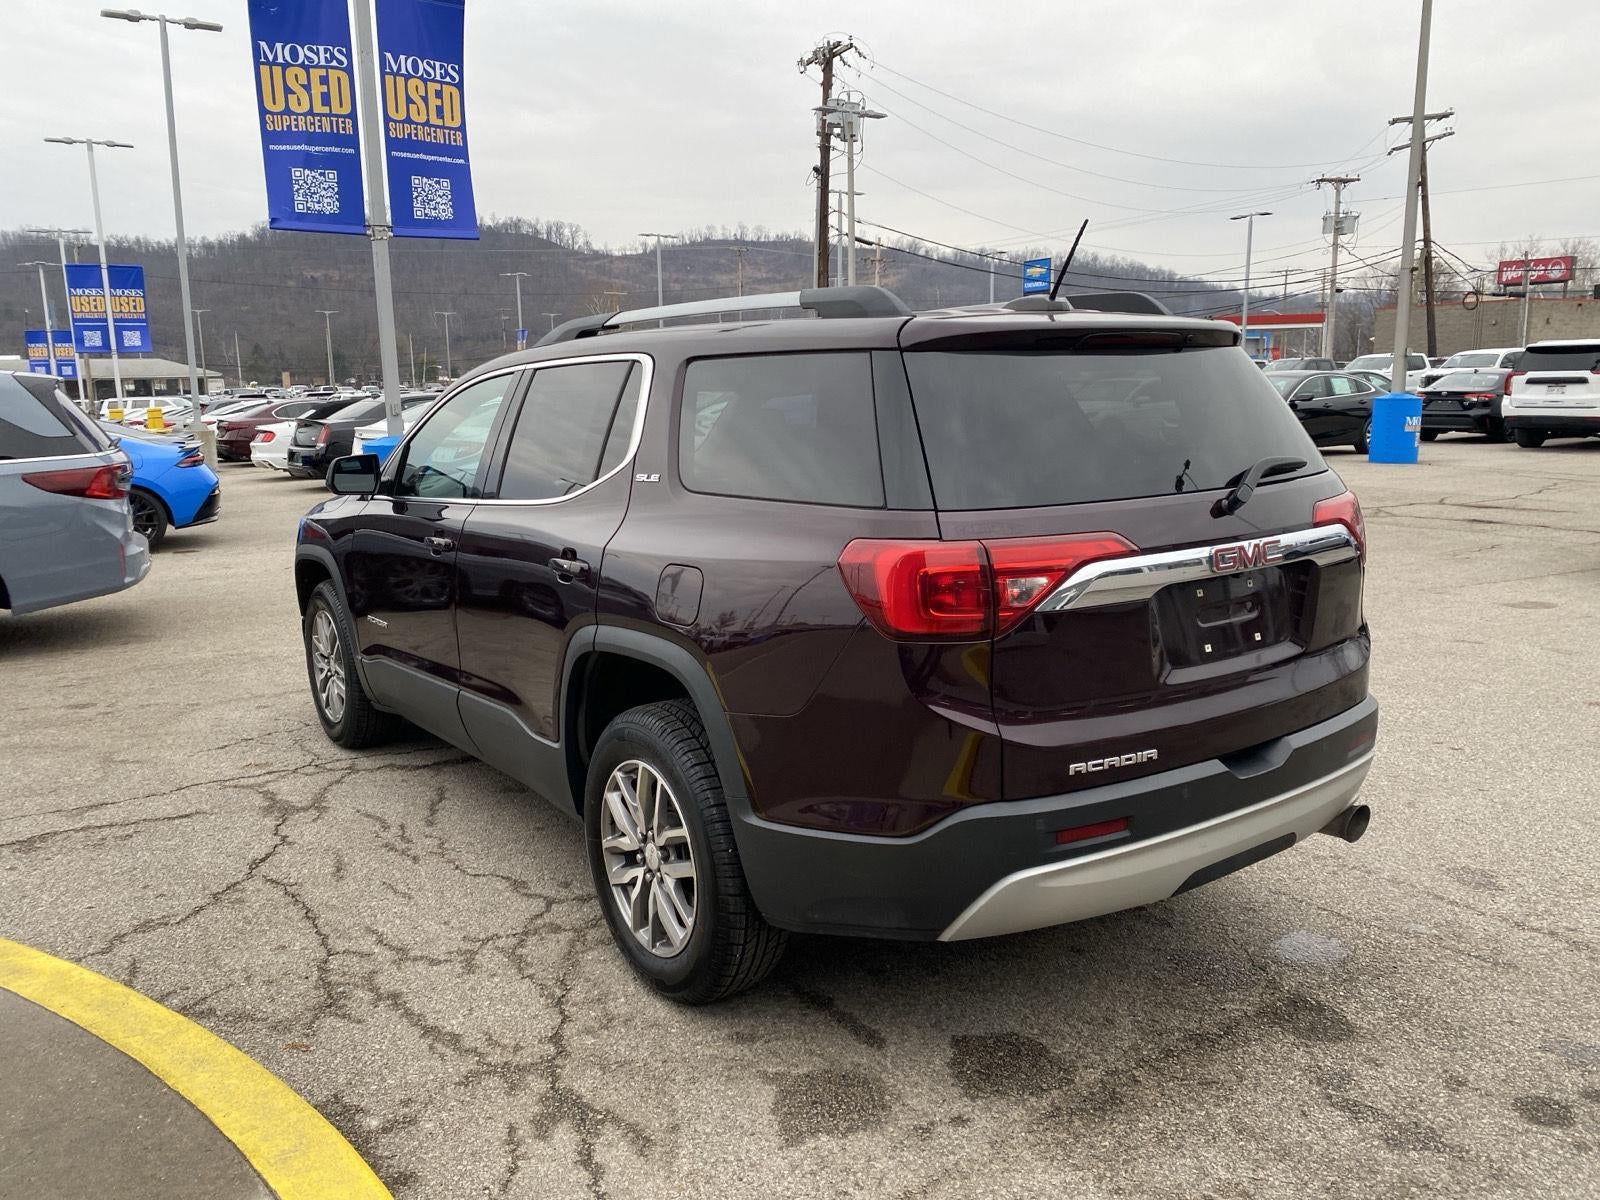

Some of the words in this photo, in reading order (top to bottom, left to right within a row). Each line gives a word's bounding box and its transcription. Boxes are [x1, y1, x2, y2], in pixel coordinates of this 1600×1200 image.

[257, 40, 348, 68] MOSES
[384, 51, 460, 84] MOSES
[260, 65, 352, 115] USED
[384, 74, 462, 128] USED
[265, 114, 353, 135] SUPERCENTER
[388, 121, 464, 147] SUPERCENTER
[269, 143, 355, 154] mosesusedsupercenter.com
[391, 150, 465, 164] mosesusedsupercenter.com
[110, 288, 143, 296] MOSES
[71, 296, 105, 312] USED
[111, 296, 145, 312] USED
[28, 348, 48, 356] USED
[55, 348, 74, 356] USED
[635, 473, 661, 482] SLE
[1211, 539, 1284, 573] GMC
[1068, 749, 1158, 776] ACADIA
